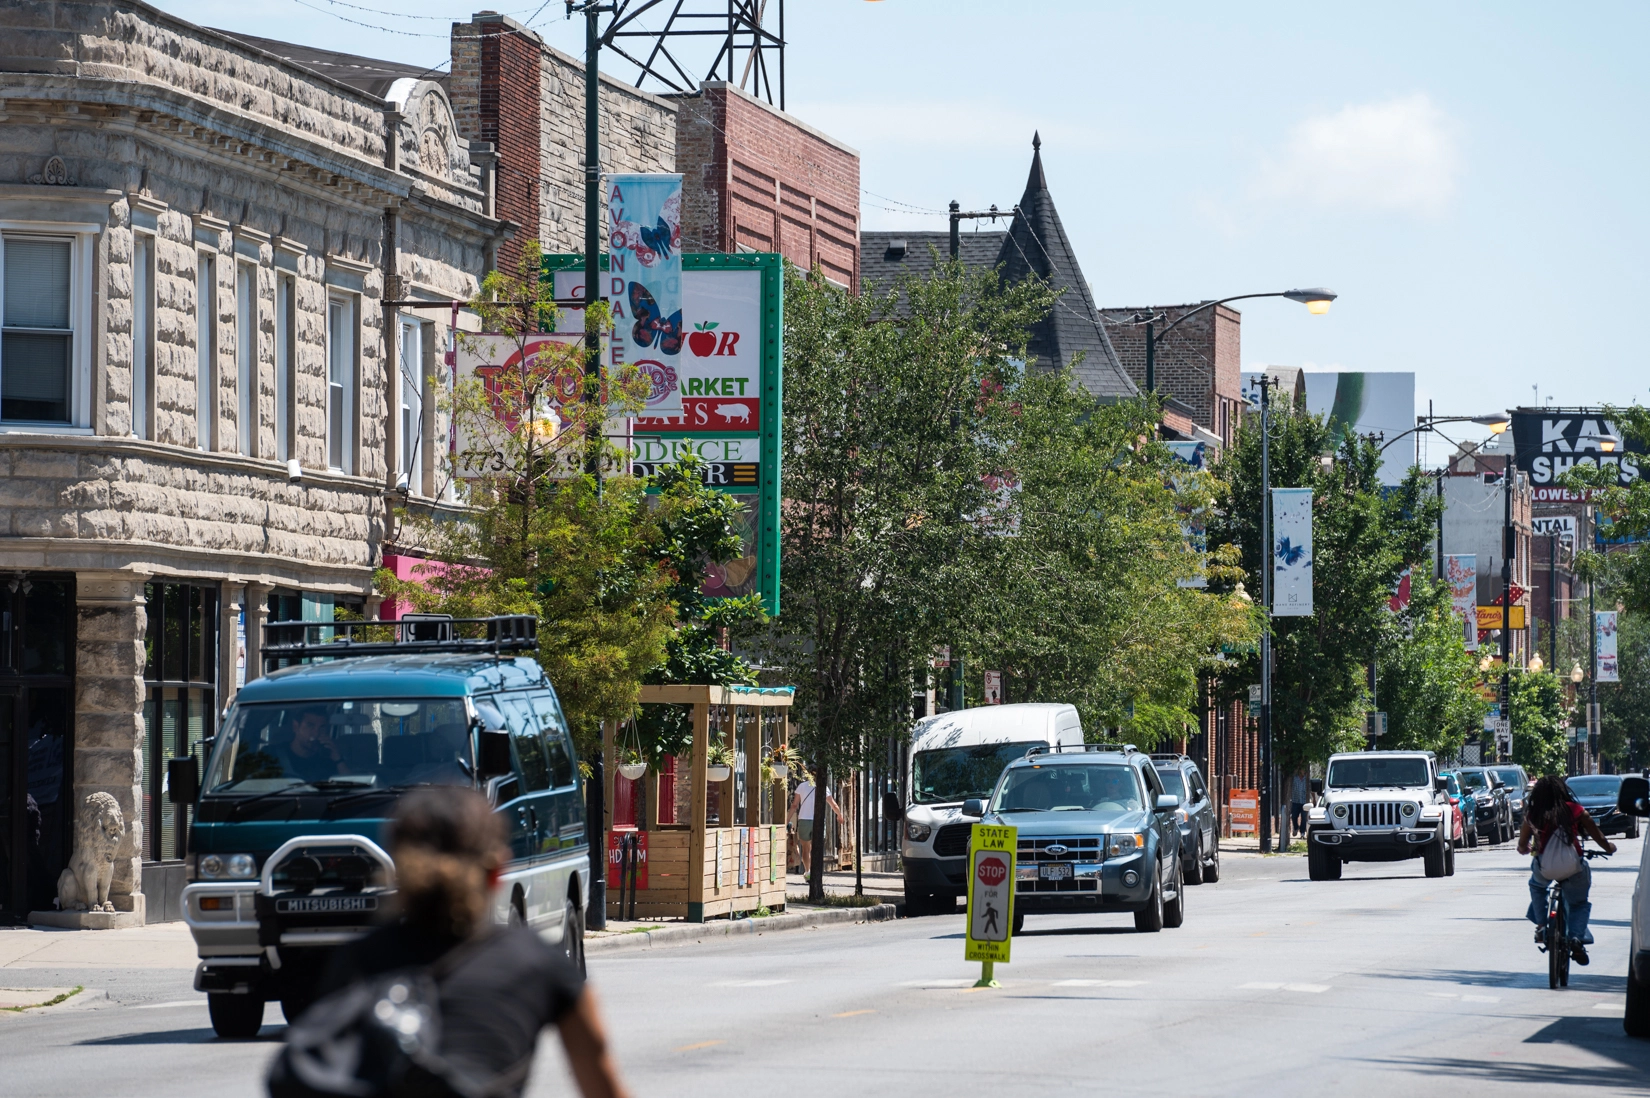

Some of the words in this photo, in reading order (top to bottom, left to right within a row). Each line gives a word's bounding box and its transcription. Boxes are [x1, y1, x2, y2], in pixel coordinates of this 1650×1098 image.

[611, 185, 625, 365] AVONDALE
[980, 828, 1009, 839] STATE
[983, 839, 1004, 848] LAW
[979, 866, 1005, 878] STOP
[1058, 867, 1070, 876] 532
[288, 898, 367, 911] MITSUBISHI
[969, 951, 1006, 960] CROSSWALK
